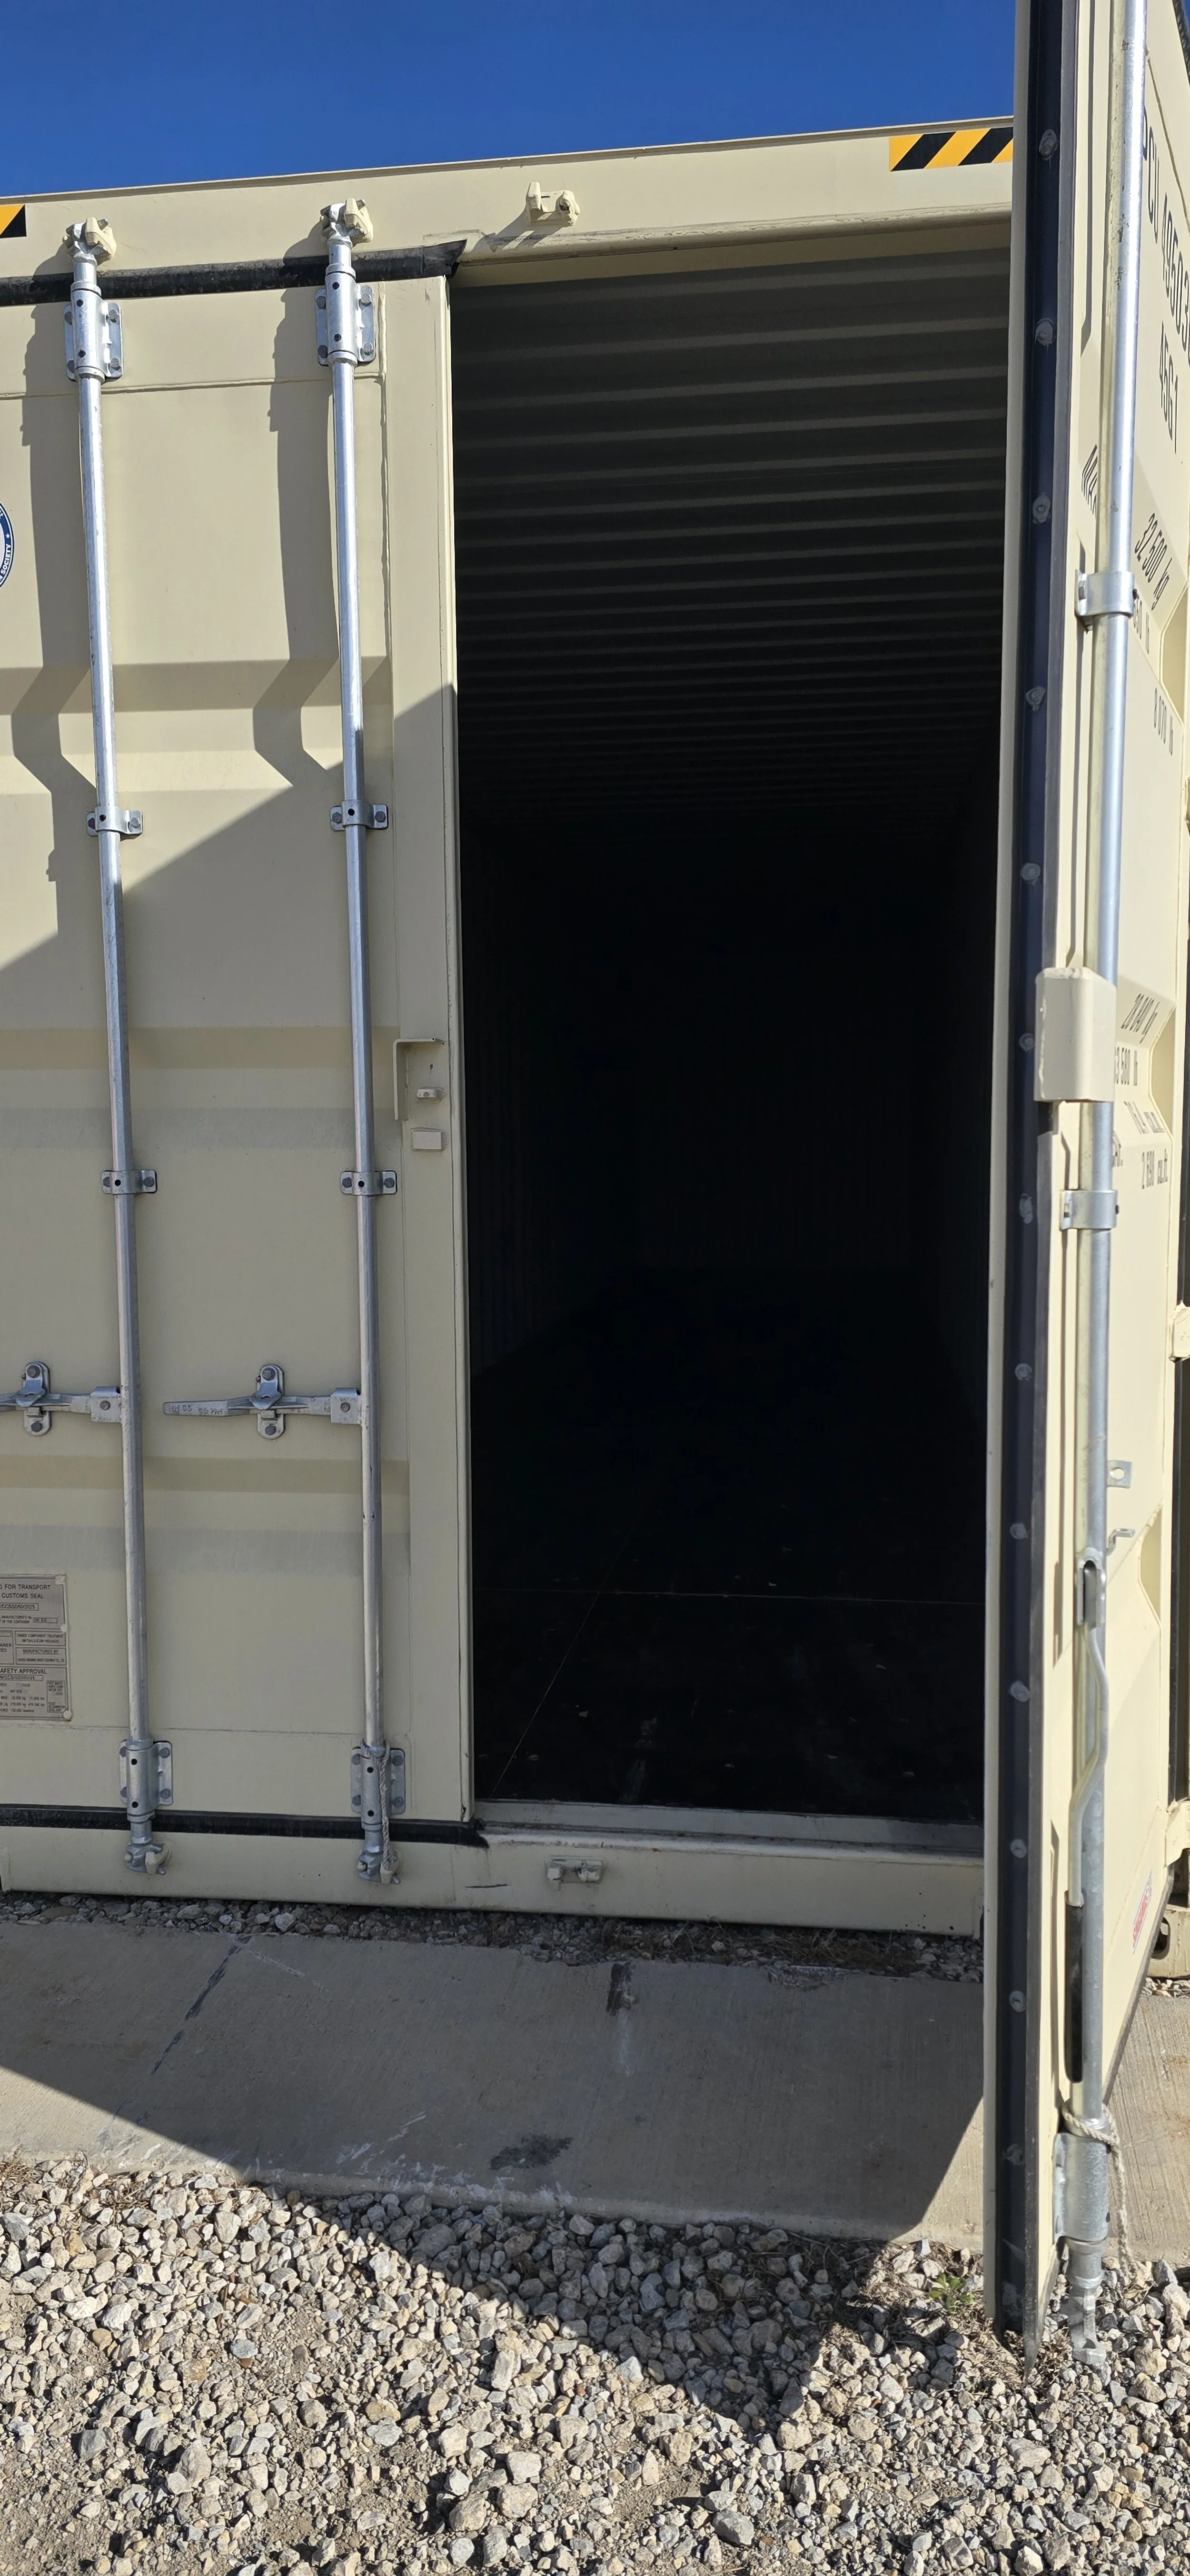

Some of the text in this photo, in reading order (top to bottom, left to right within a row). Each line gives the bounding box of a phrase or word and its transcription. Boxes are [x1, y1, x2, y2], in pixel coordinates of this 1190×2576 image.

[1161, 192, 1190, 367] 49503
[1159, 321, 1179, 454] 45G1
[1, 544, 11, 575] SOCIETY
[1151, 557, 1172, 611] kg
[1145, 612, 1150, 655] lb
[1169, 714, 1173, 756] lb
